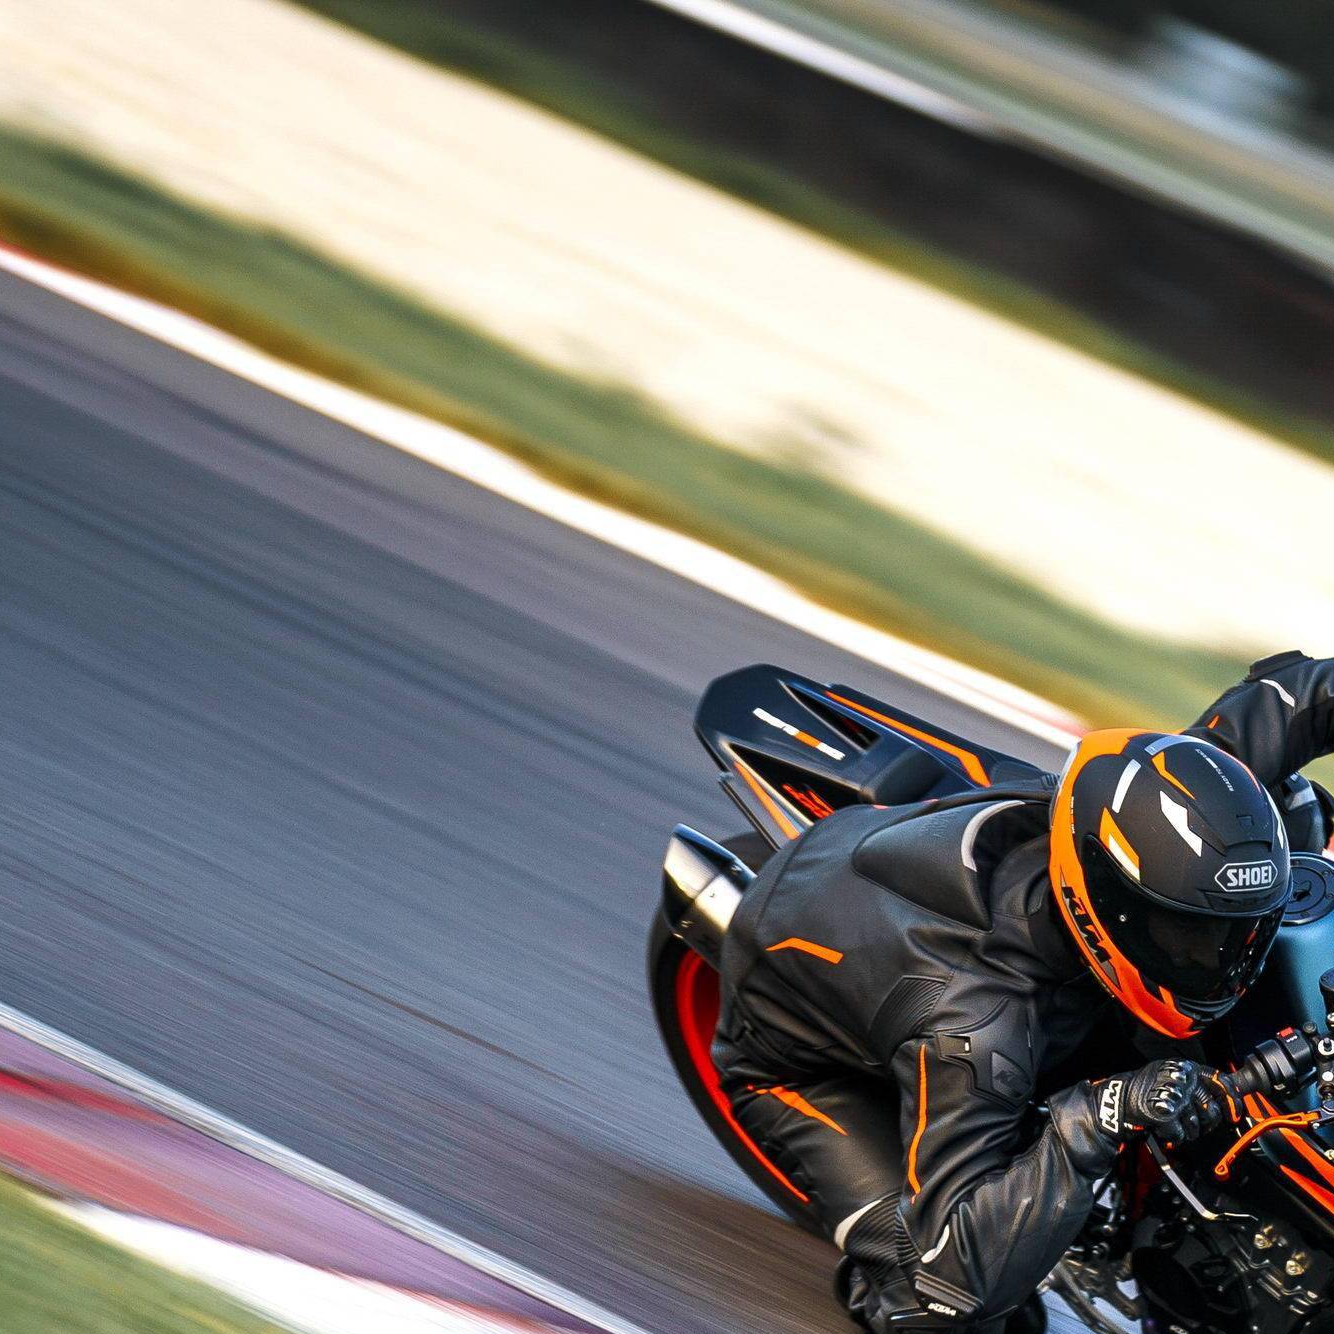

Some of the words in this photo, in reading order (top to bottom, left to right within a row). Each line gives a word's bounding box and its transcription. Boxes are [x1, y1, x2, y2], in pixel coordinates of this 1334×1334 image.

[1227, 865, 1272, 887] SHOEI
[1061, 886, 1113, 964] KTM
[1099, 1080, 1123, 1133] KTM
